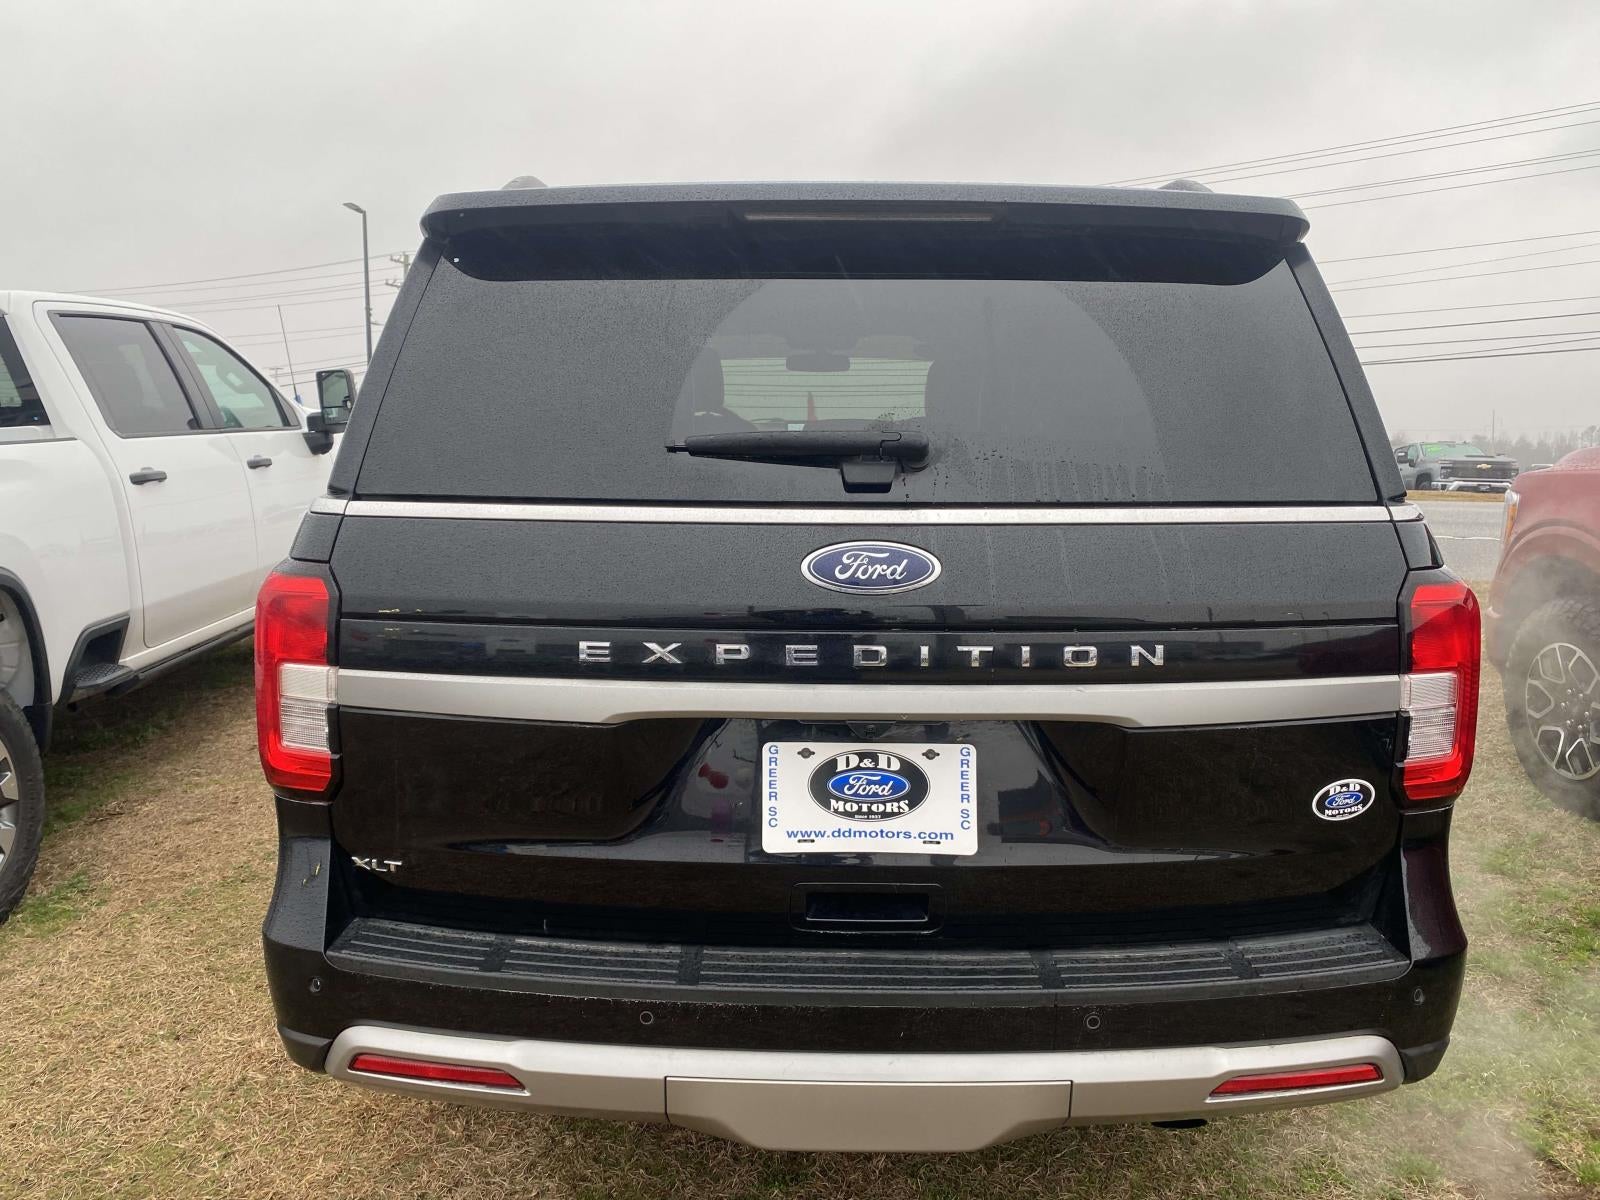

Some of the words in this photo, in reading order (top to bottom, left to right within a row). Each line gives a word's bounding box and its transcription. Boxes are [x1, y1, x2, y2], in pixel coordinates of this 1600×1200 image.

[835, 551, 908, 580] Ford
[578, 640, 1164, 669] EXPEDITION
[835, 753, 901, 772] D&D
[768, 745, 779, 801] GREER
[960, 747, 971, 803] GREER
[843, 774, 893, 796] Ford
[1329, 783, 1361, 796] D&D
[829, 799, 910, 813] MOTORS
[1324, 803, 1363, 817] MOTORS
[1332, 794, 1356, 806] Ford
[768, 806, 778, 828] SC
[960, 808, 971, 830] SC
[786, 828, 954, 841] www.ddmotors.com
[351, 856, 403, 872] XLT
